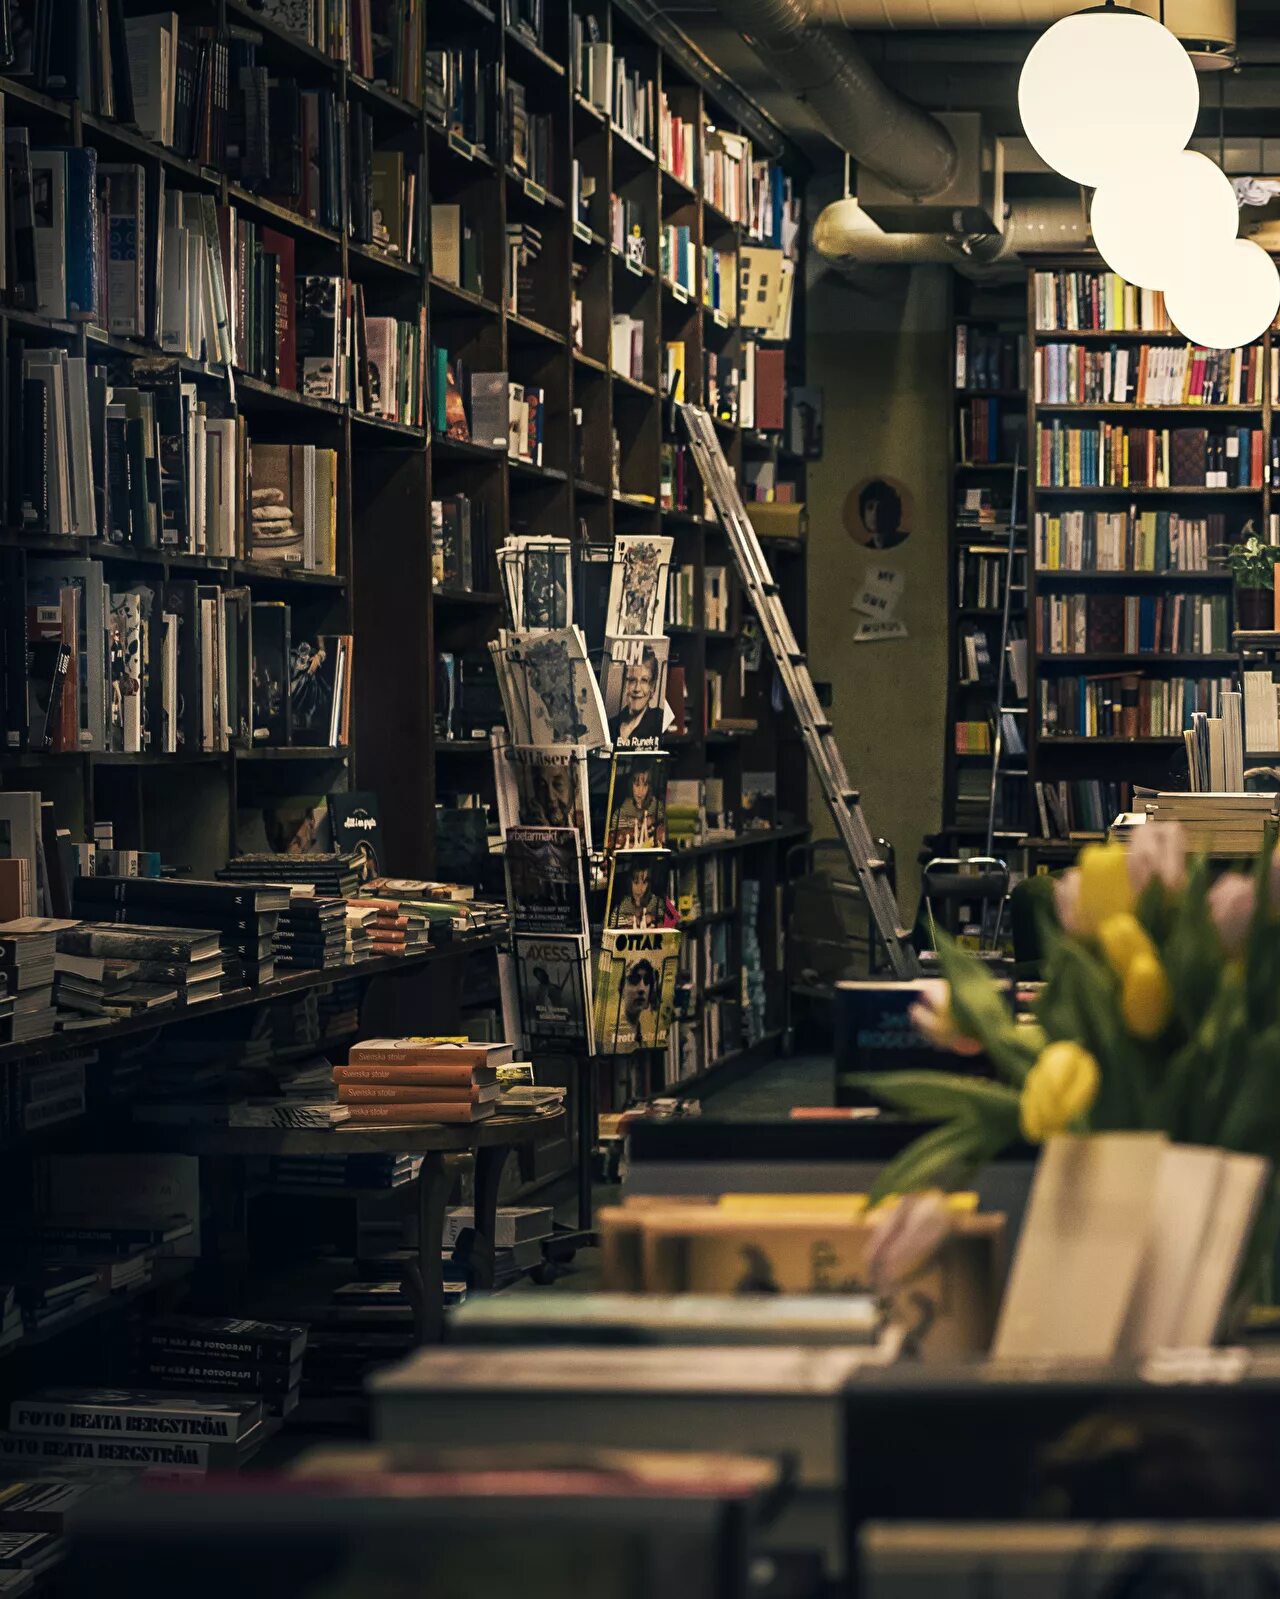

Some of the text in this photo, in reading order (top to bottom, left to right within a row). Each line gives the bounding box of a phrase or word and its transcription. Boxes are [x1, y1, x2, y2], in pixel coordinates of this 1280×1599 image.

[877, 571, 895, 583] MY
[862, 593, 888, 610] OWN
[615, 934, 663, 951] OTTAR
[527, 945, 570, 961] AXESS
[358, 1052, 407, 1062] Svenska stolar
[342, 1070, 370, 1078] Svenska
[347, 1088, 397, 1097] Svenska stolar
[370, 1108, 389, 1116] stolar
[204, 1341, 252, 1352] FOTOGRAFI
[202, 1368, 251, 1378] FOTOGRAFI
[18, 1410, 229, 1437] FOTO BEATA BERGSTRÖM
[43, 1440, 94, 1458] BEATA
[98, 1440, 199, 1465] BERGSTRÖM
